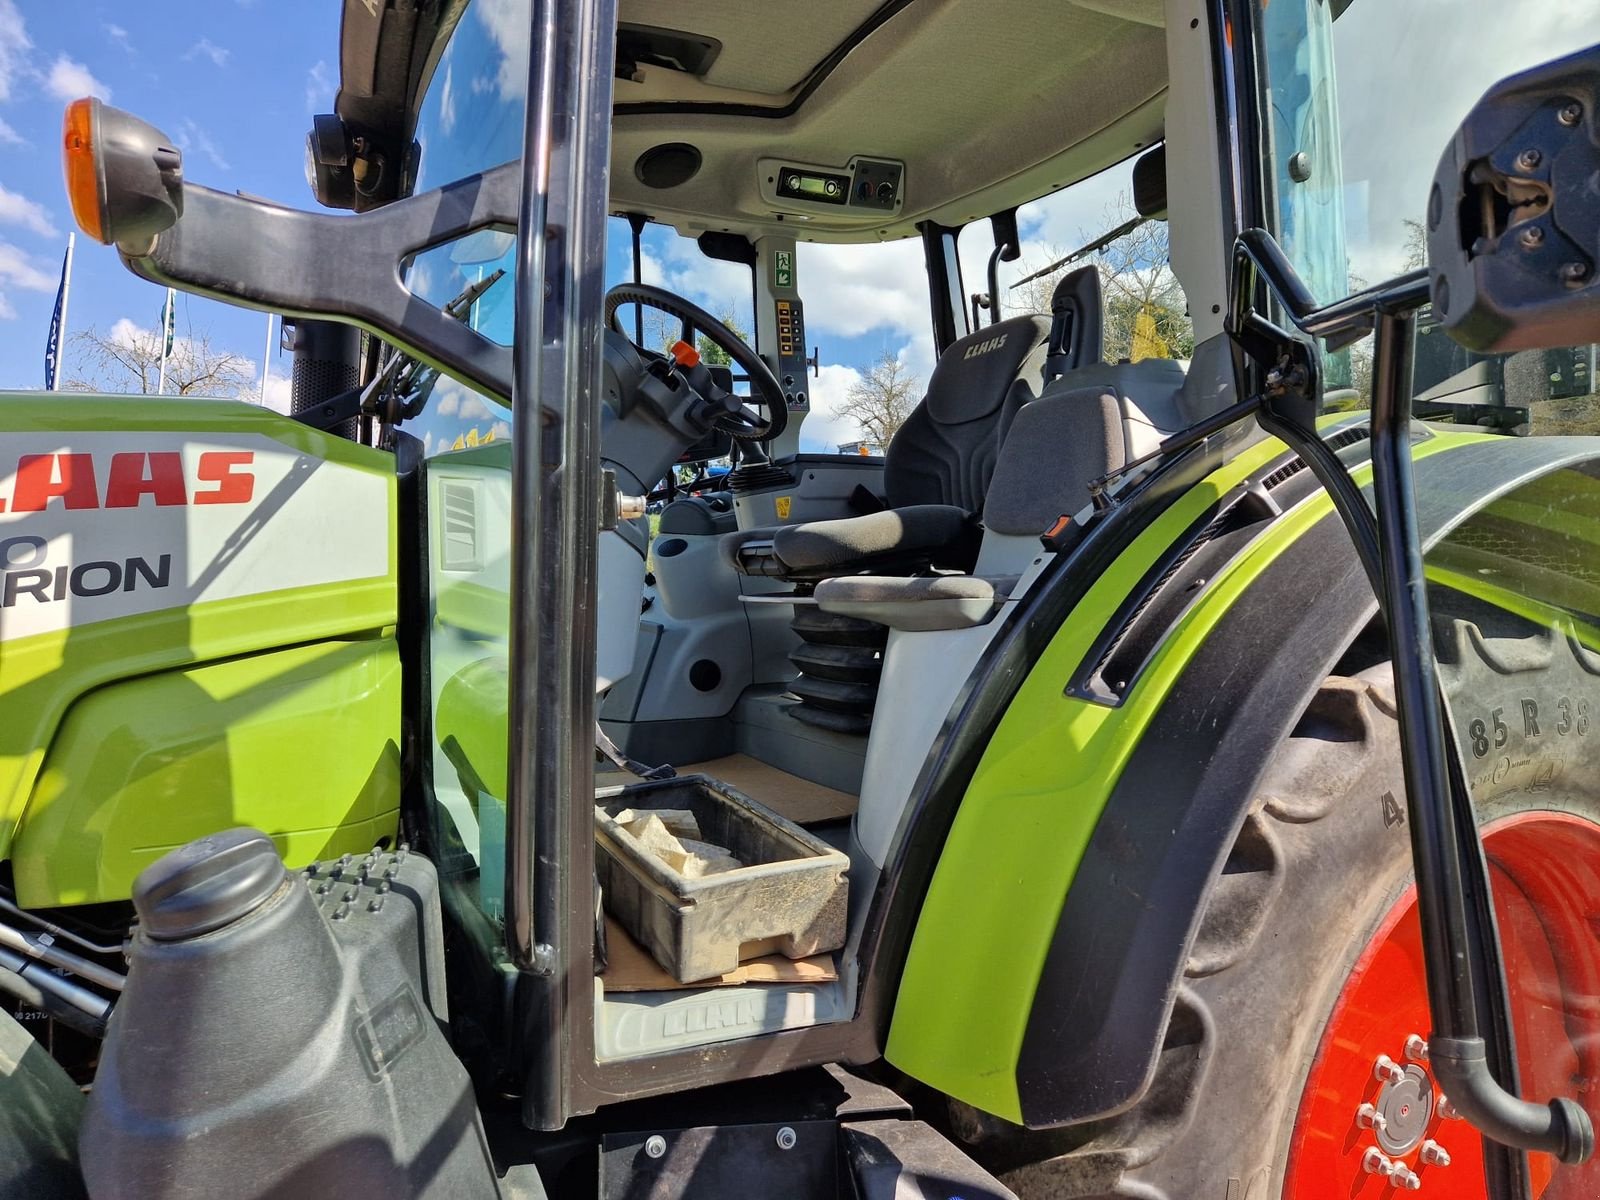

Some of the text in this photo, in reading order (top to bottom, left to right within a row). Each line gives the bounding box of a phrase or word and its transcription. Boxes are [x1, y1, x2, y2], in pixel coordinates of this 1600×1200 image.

[964, 334, 1008, 359] CLAAS
[0, 452, 255, 512] AAS
[0, 554, 171, 608] RION
[1468, 706, 1508, 760] 85
[1521, 697, 1541, 738] R
[1556, 695, 1591, 738] 38
